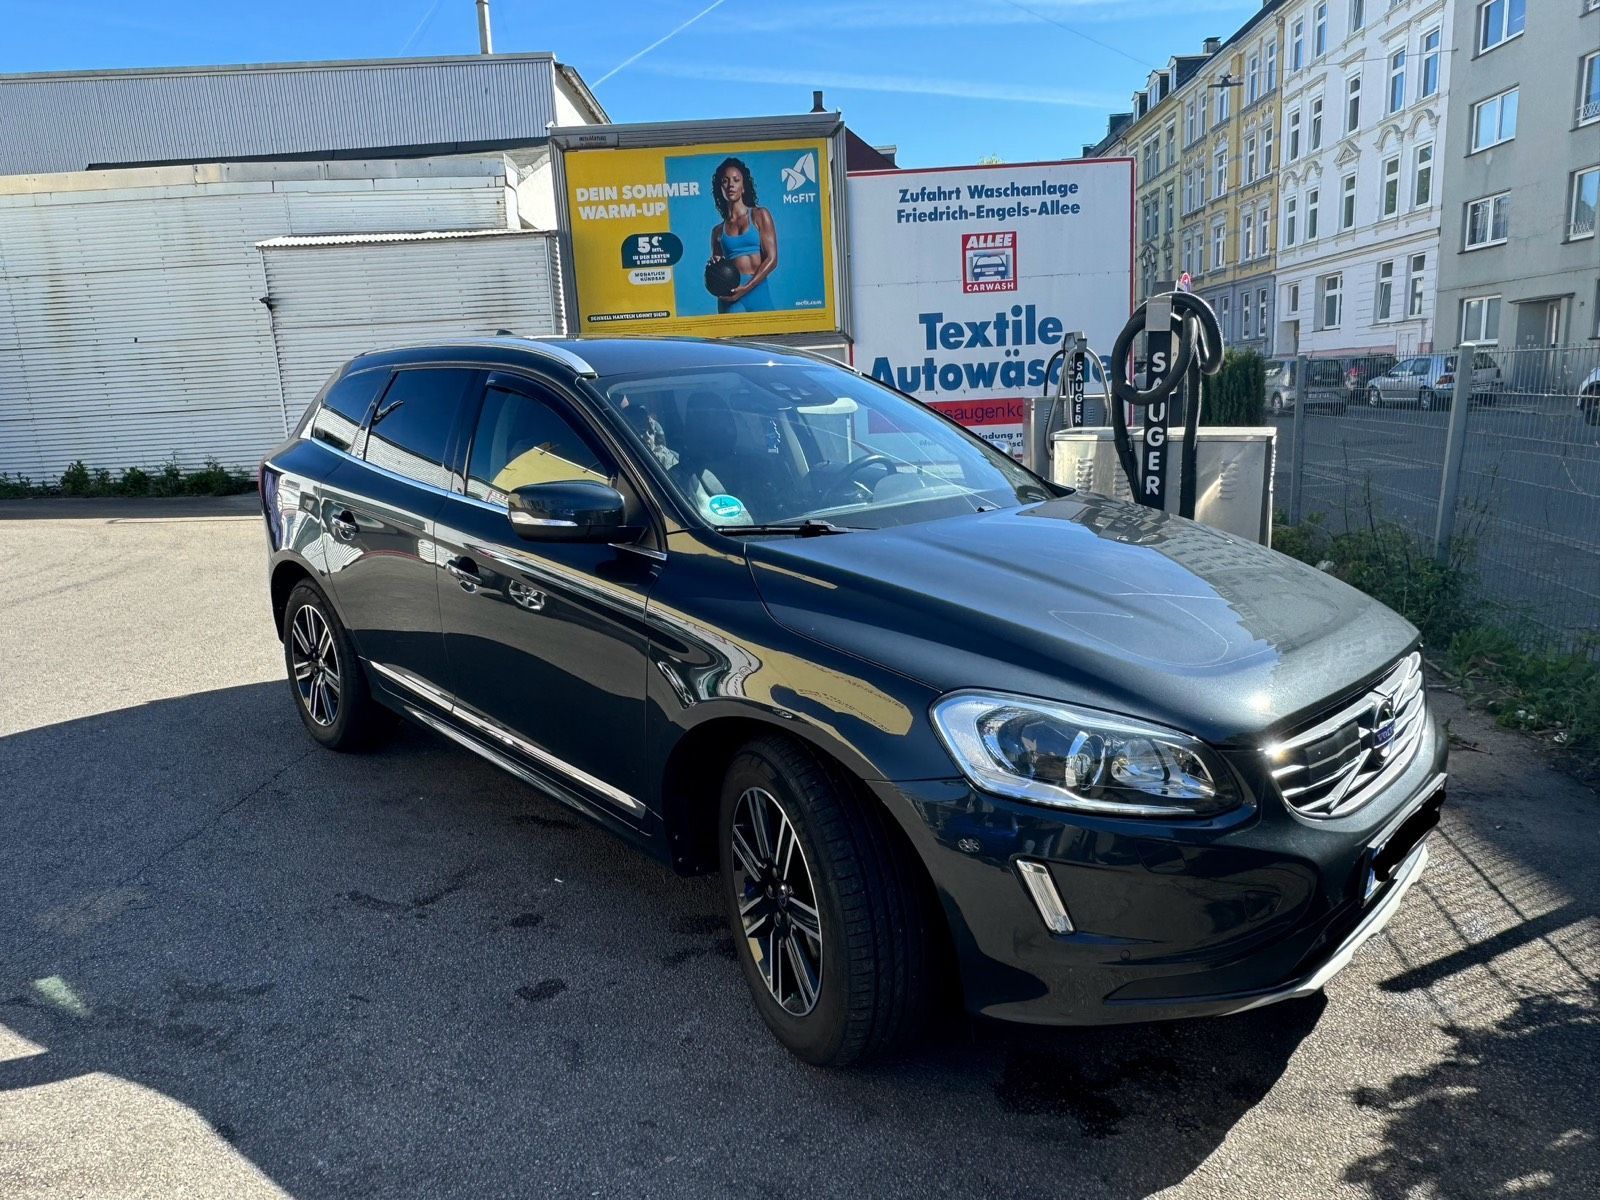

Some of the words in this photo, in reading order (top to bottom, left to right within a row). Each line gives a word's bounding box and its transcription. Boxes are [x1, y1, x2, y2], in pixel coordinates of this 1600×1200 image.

[576, 186, 618, 202] DEIN
[622, 182, 700, 200] SOMMER
[783, 193, 816, 204] McFIT
[899, 186, 962, 203] Zufahrt
[967, 180, 1079, 200] Waschanlage
[578, 202, 666, 220] WARM-UP
[896, 201, 1081, 224] Friedrich-Engels-Allee
[637, 236, 651, 253] 5
[966, 233, 1013, 249] ALLEE
[966, 282, 1015, 292] CARWASH
[918, 304, 1063, 350] Textile
[1074, 361, 1083, 424] SAUGER
